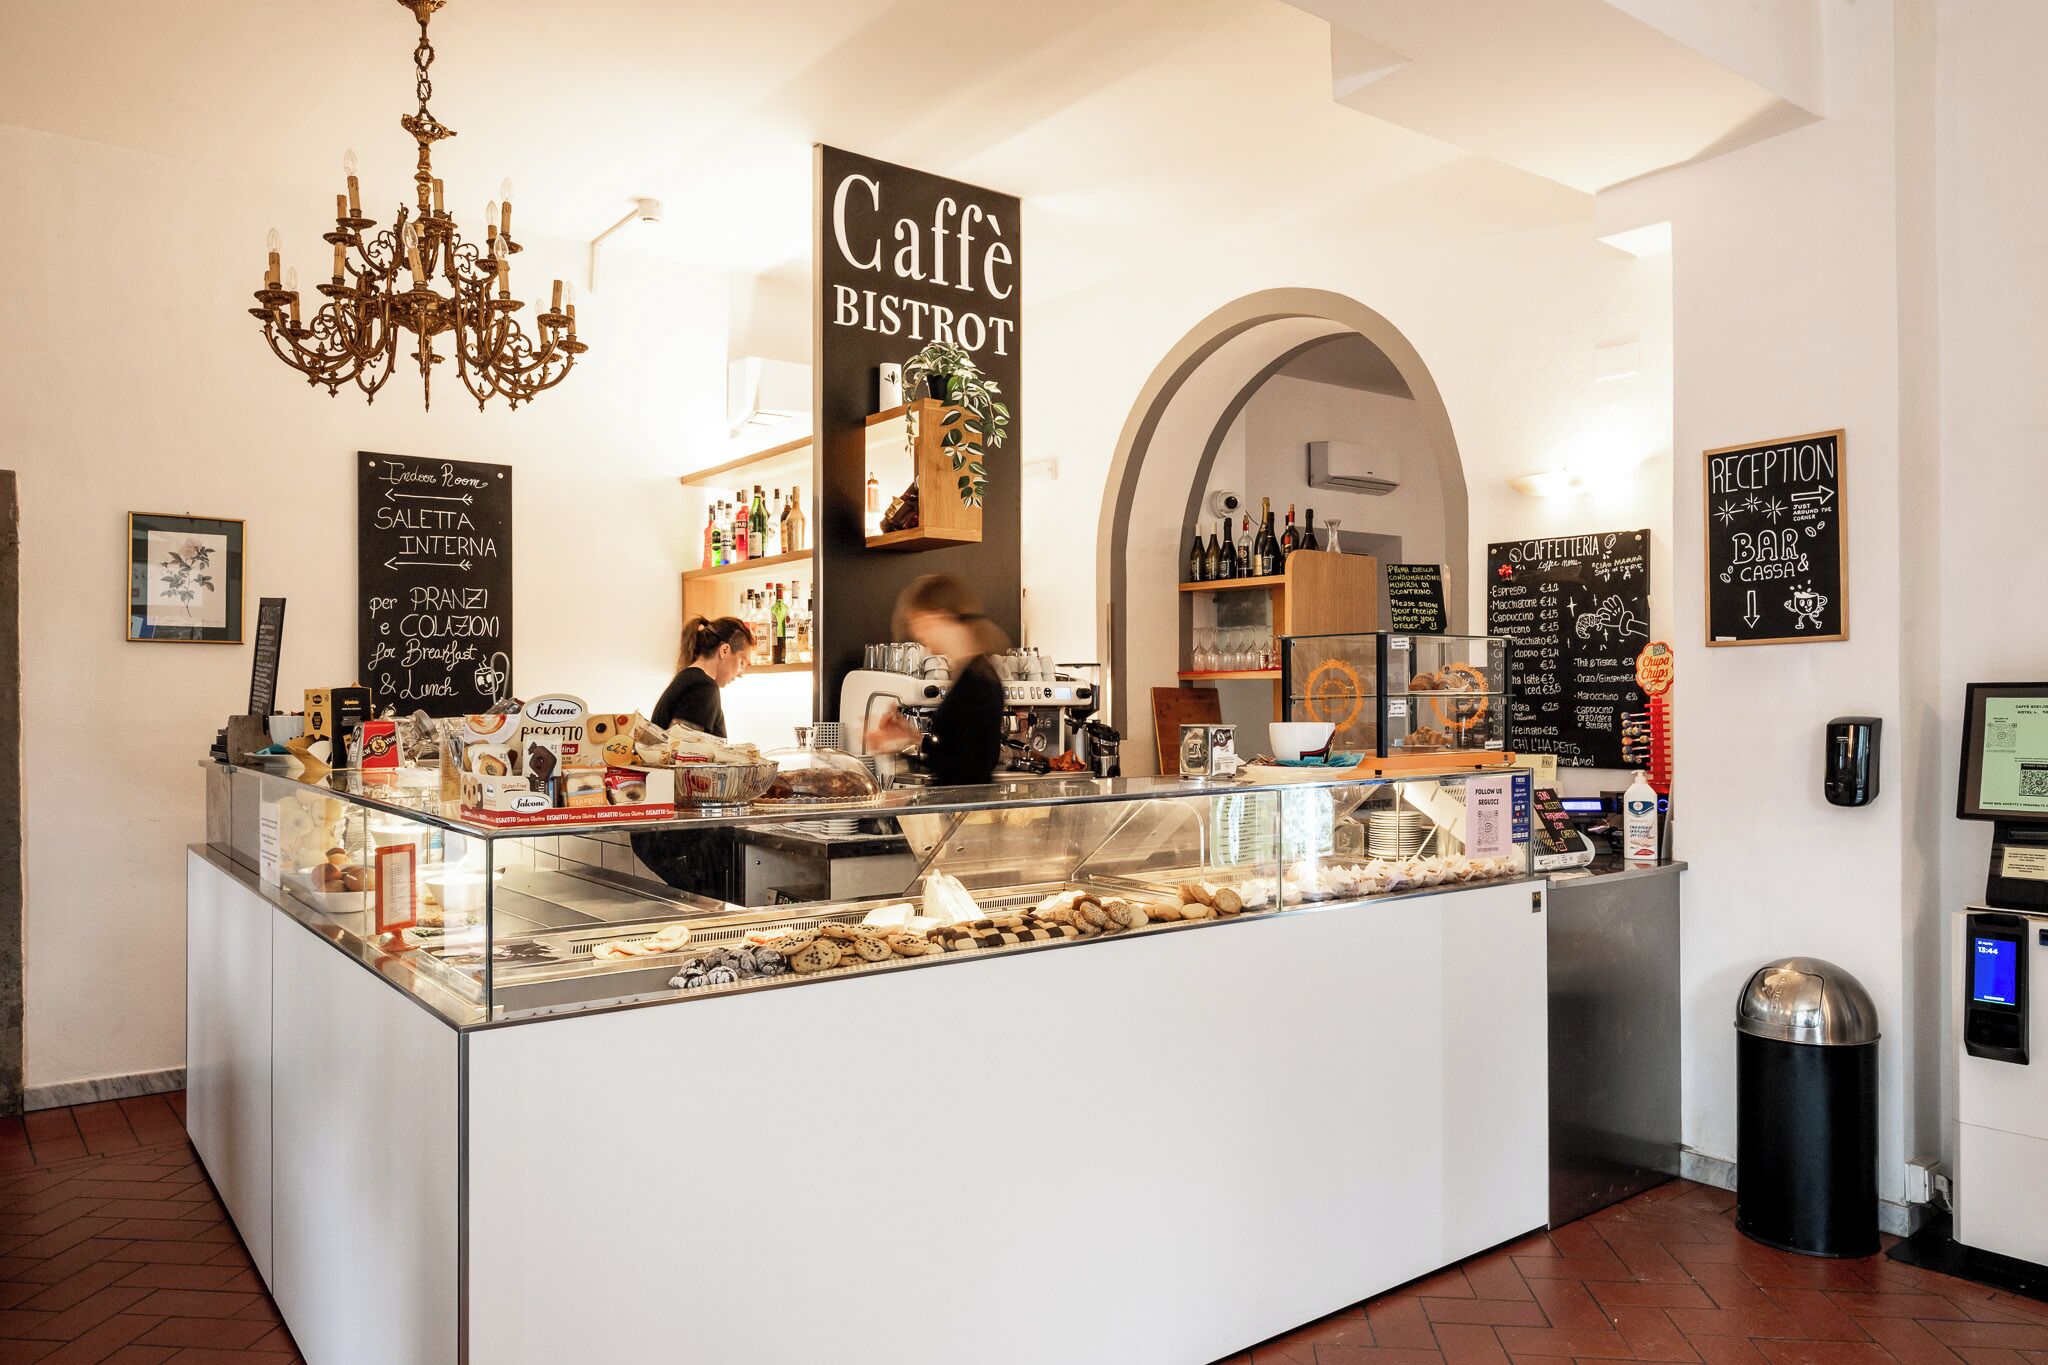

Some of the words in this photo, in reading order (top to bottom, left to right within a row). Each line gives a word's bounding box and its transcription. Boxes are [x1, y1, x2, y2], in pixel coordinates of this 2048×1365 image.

[833, 173, 1013, 300] Caffè
[833, 284, 1014, 356] BISTROT
[378, 460, 436, 484] Indoor
[441, 463, 489, 488] Room
[1711, 443, 1834, 494] RECEPTION
[374, 507, 475, 531] SALETTA
[1793, 514, 1816, 522] CORNER
[399, 536, 497, 558] INTERNA
[1523, 536, 1599, 561] CAFFETTERIA
[1732, 528, 1799, 565] BAR
[1740, 562, 1795, 582] CASSA
[1797, 553, 1809, 572] &
[1492, 585, 1527, 597] Espresso
[369, 596, 398, 619] per
[410, 586, 488, 611] PRANZI
[1390, 599, 1416, 607] Please
[1492, 598, 1538, 610] Macchiatone
[1391, 608, 1411, 616] your
[1492, 612, 1534, 623] Cappuccino
[380, 621, 391, 635] e
[400, 614, 500, 638] COLAZIONI
[1420, 616, 1435, 624] you
[1493, 625, 1531, 634] Americano
[368, 643, 396, 671] for
[401, 638, 478, 671] Breakfast
[1514, 648, 1539, 658] doppio
[1540, 660, 1557, 670] €2
[1642, 655, 1670, 670] Chupa
[1523, 673, 1540, 685] latte
[1641, 668, 1669, 681] Chups
[380, 672, 397, 695] &
[400, 669, 459, 699] Lunch
[1524, 686, 1542, 695] iced
[1577, 691, 1619, 701] Marocchino
[533, 703, 577, 718] falcone
[1553, 740, 1581, 755] DETTO
[516, 798, 545, 809] falcone
[1978, 946, 1999, 955] 13:44
